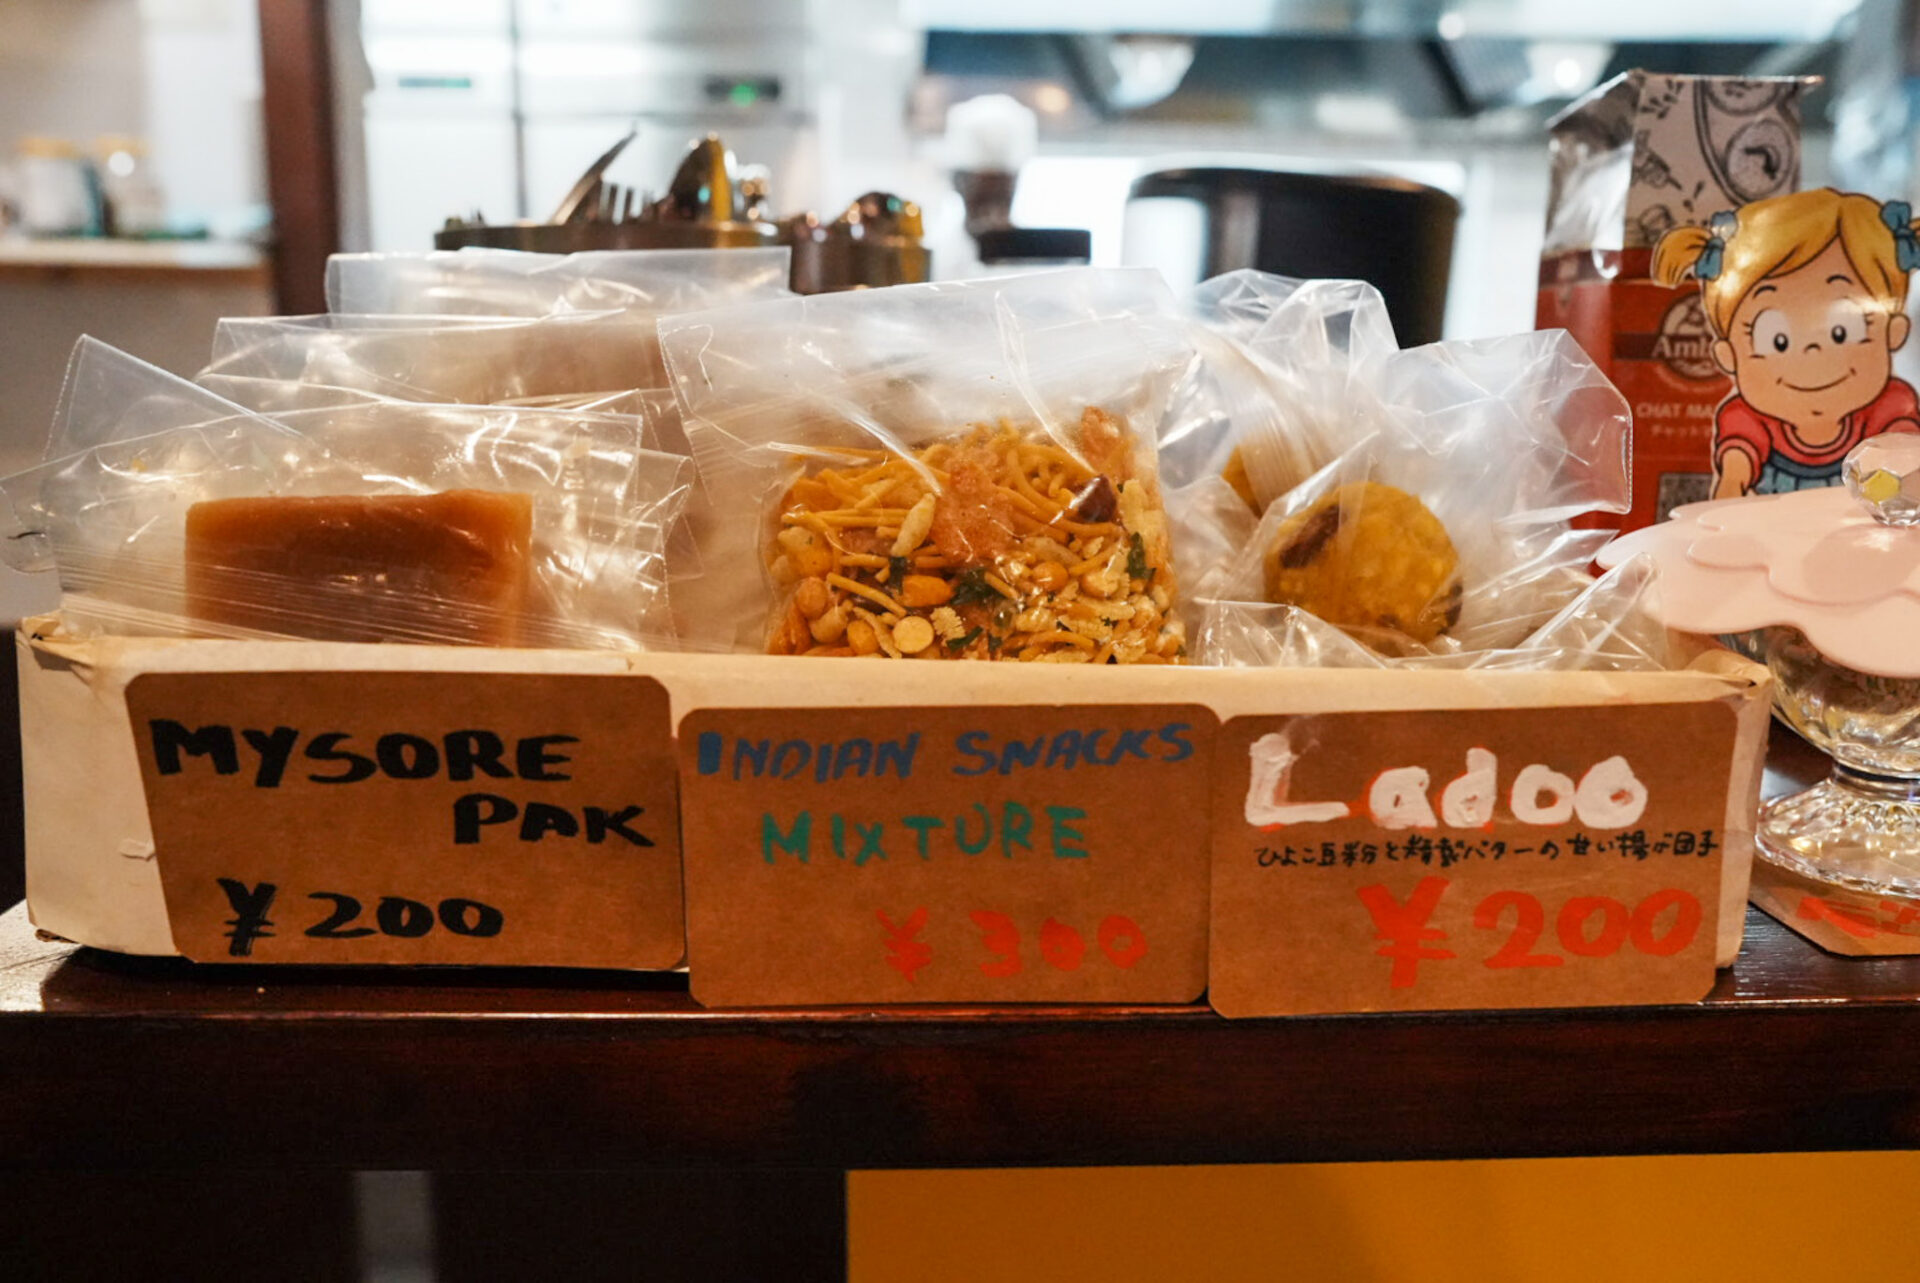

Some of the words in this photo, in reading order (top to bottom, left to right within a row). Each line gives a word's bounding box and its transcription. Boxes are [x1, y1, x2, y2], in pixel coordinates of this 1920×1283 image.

[1636, 402, 1681, 419] CHAT
[148, 719, 581, 789] MYSORE
[696, 730, 922, 784] INDIAN
[951, 722, 1196, 777] SNACKS
[1244, 731, 1649, 832] Ladoo
[452, 792, 655, 848] PAK
[760, 800, 1090, 867] MIXTURE
